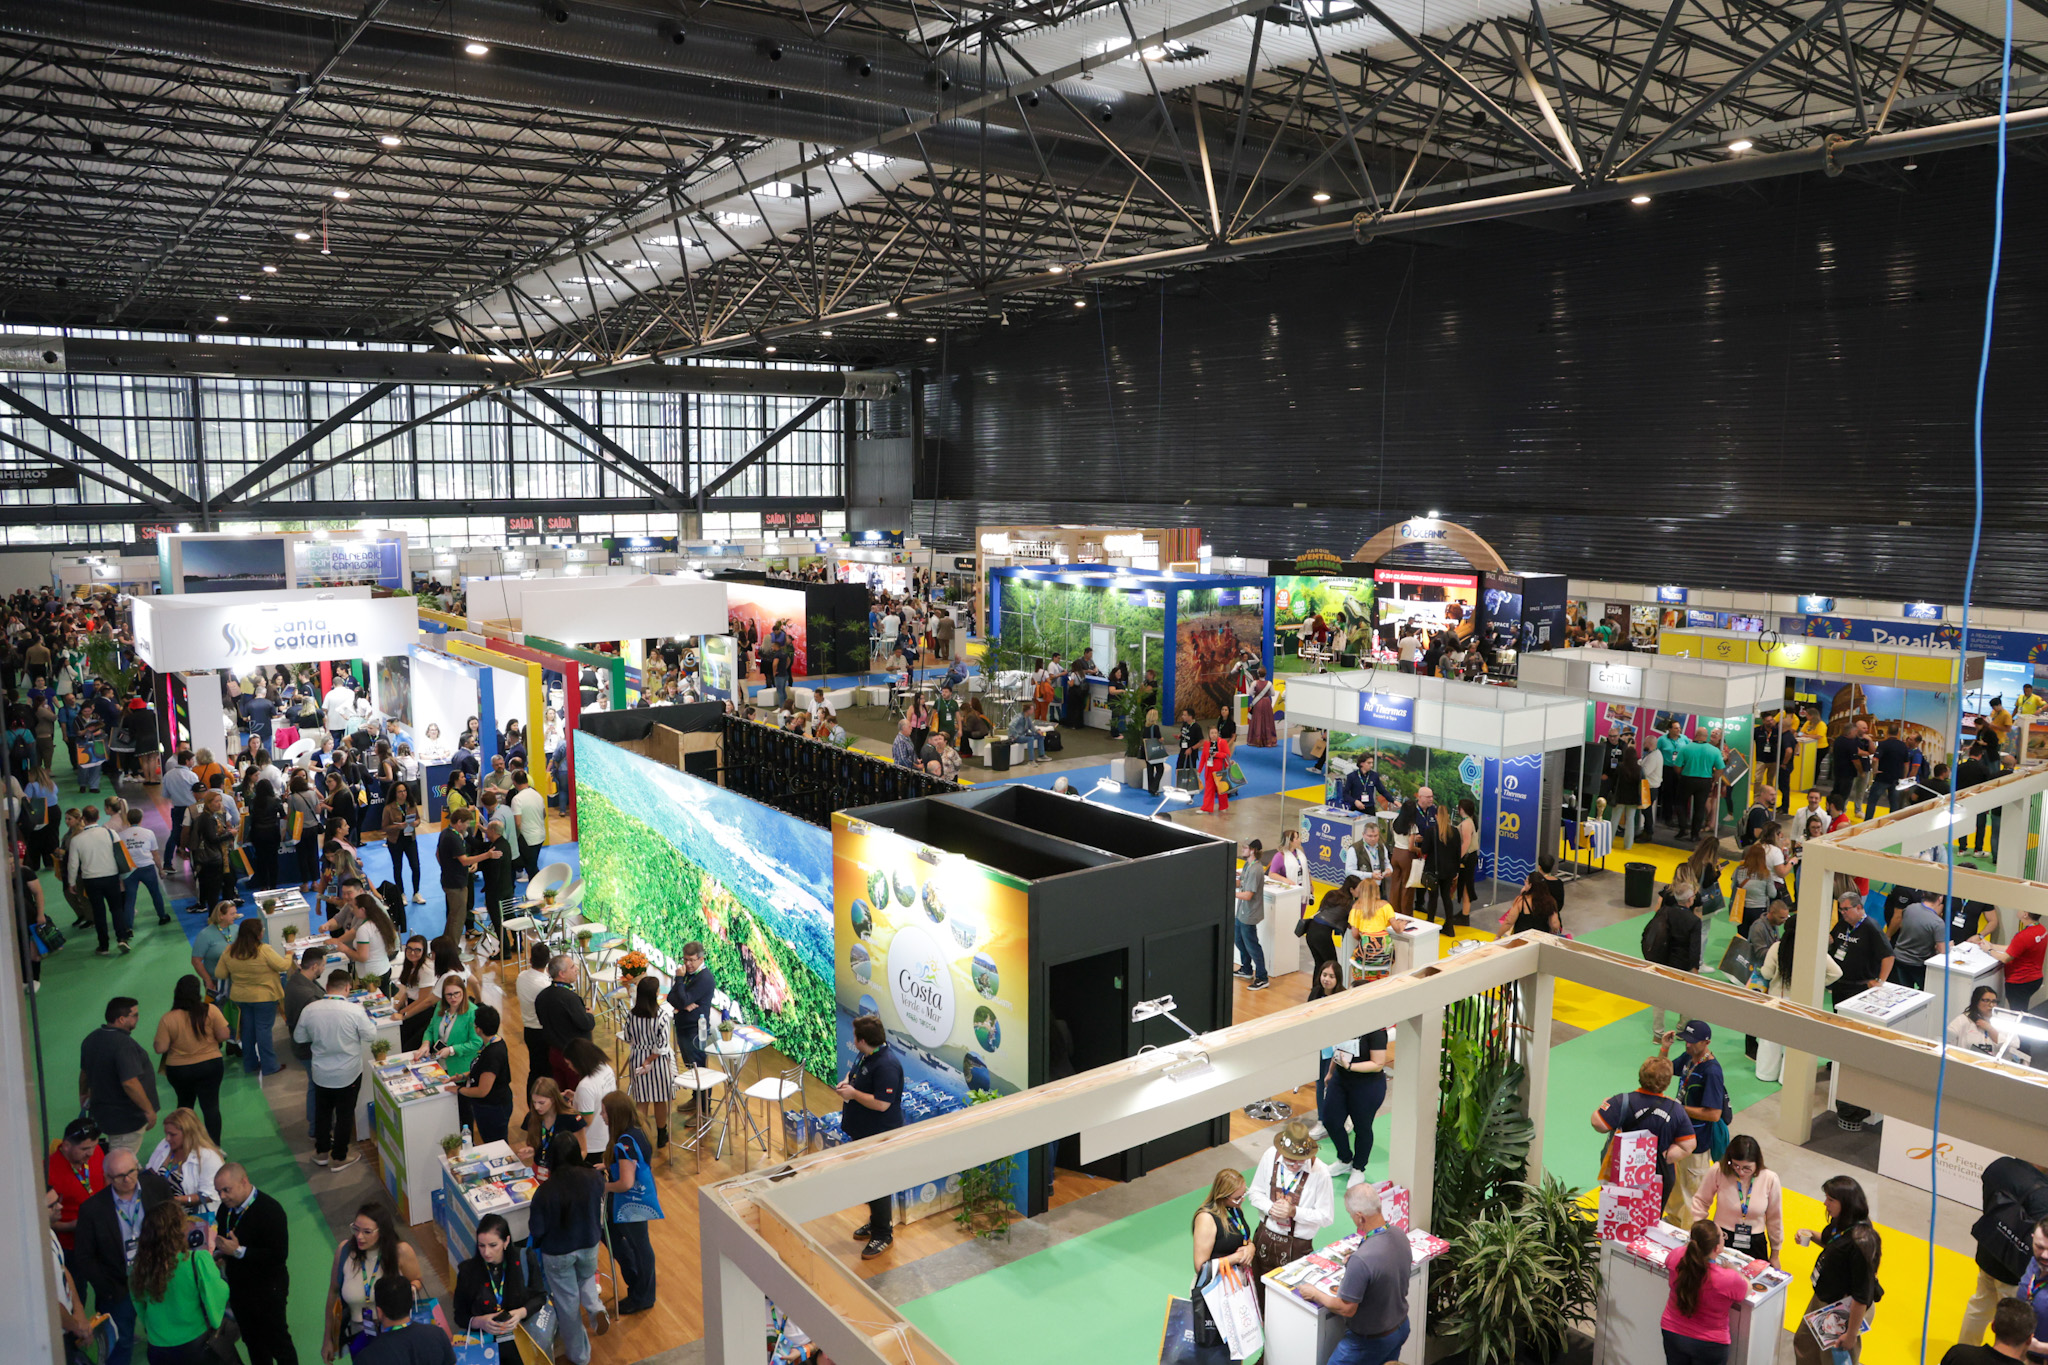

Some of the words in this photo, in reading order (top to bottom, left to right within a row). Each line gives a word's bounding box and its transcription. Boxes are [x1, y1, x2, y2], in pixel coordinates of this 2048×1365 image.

[509, 516, 535, 530] SAÍDA
[548, 515, 572, 529] SAÍDA
[765, 512, 786, 525] SAÍDA
[796, 512, 816, 525] SAÍDA
[1413, 529, 1447, 540] OCEANIC
[1295, 553, 1342, 564] AVENTURA
[1486, 572, 1496, 580] SPACE
[1498, 574, 1518, 585] ADVENTURE
[274, 618, 326, 633] santa
[274, 631, 356, 648] catarina
[1376, 703, 1407, 717] Thermas
[1503, 788, 1527, 800] Thermas
[1500, 811, 1520, 832] 20
[1499, 830, 1519, 840] anos
[1319, 844, 1332, 858] 20
[899, 968, 943, 1011] Costa
[901, 992, 920, 1013] Verde
[926, 1006, 942, 1023] Mar
[1935, 1157, 1982, 1180] Americana
[1956, 1155, 1983, 1172] Fiesta
